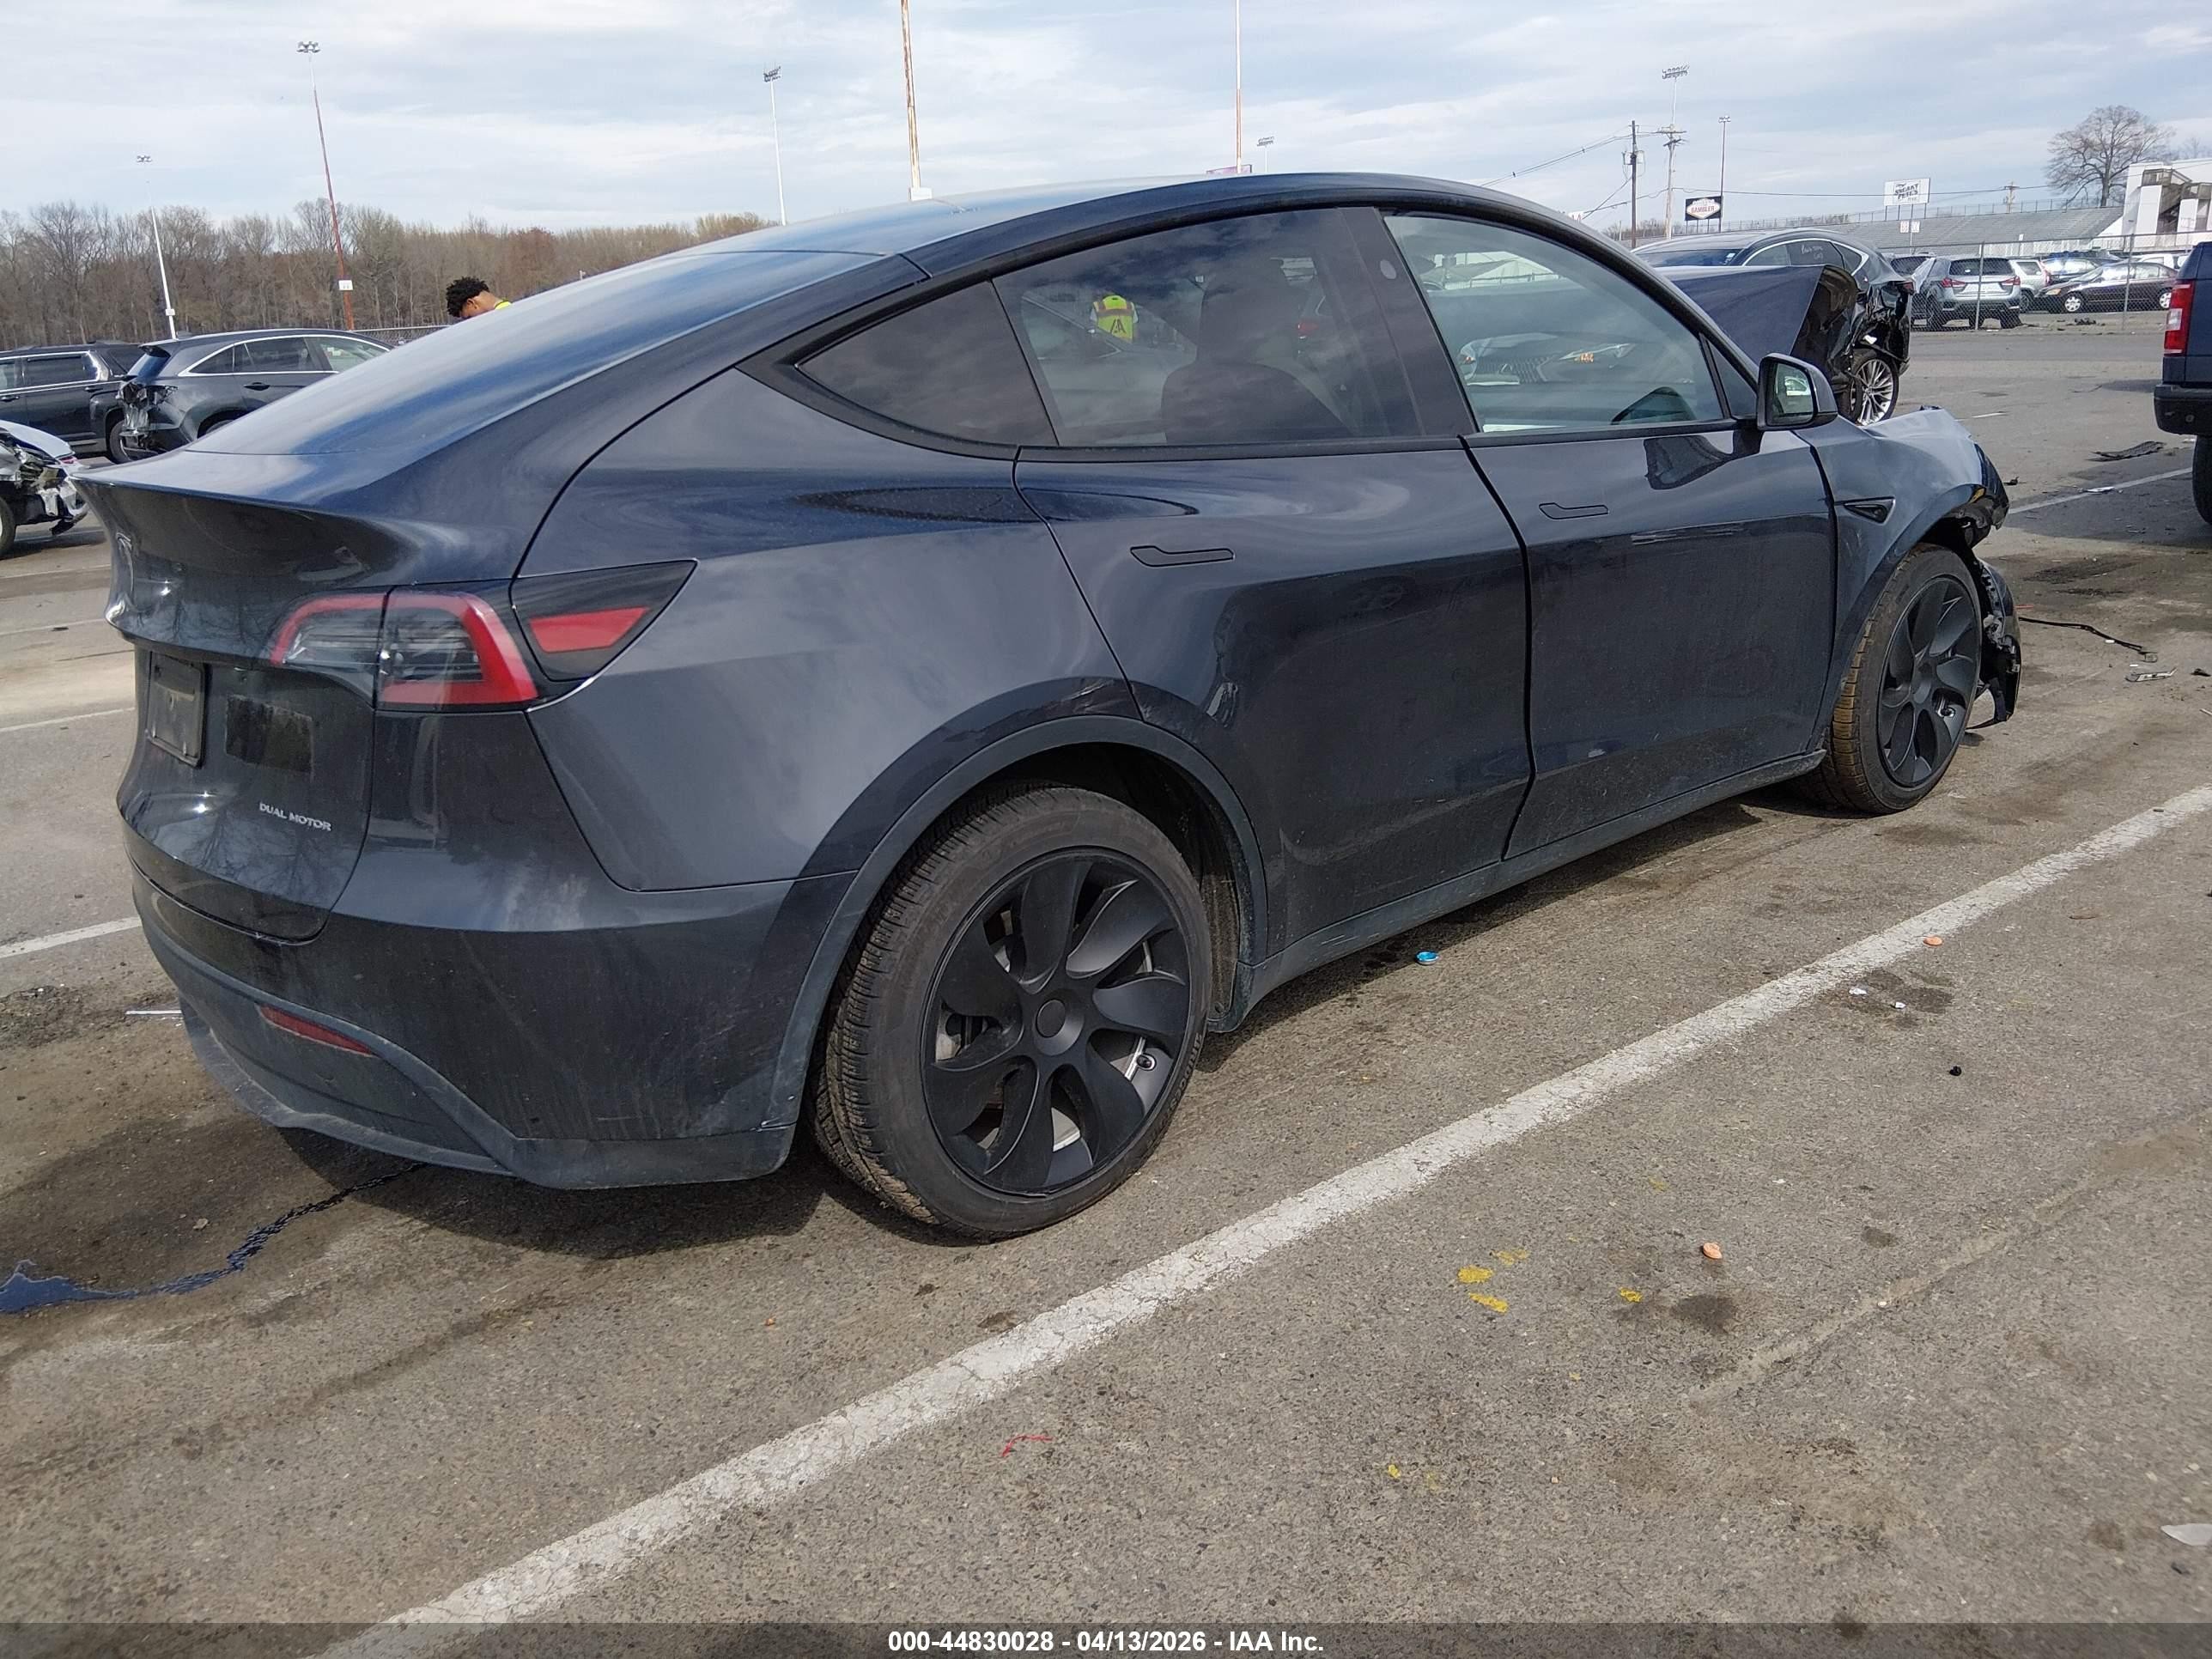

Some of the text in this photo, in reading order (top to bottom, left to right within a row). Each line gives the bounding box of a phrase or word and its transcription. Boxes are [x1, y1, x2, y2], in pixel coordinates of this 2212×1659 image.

[1691, 205, 1715, 214] GAMBLER
[259, 802, 331, 832] DUAL MOTOR
